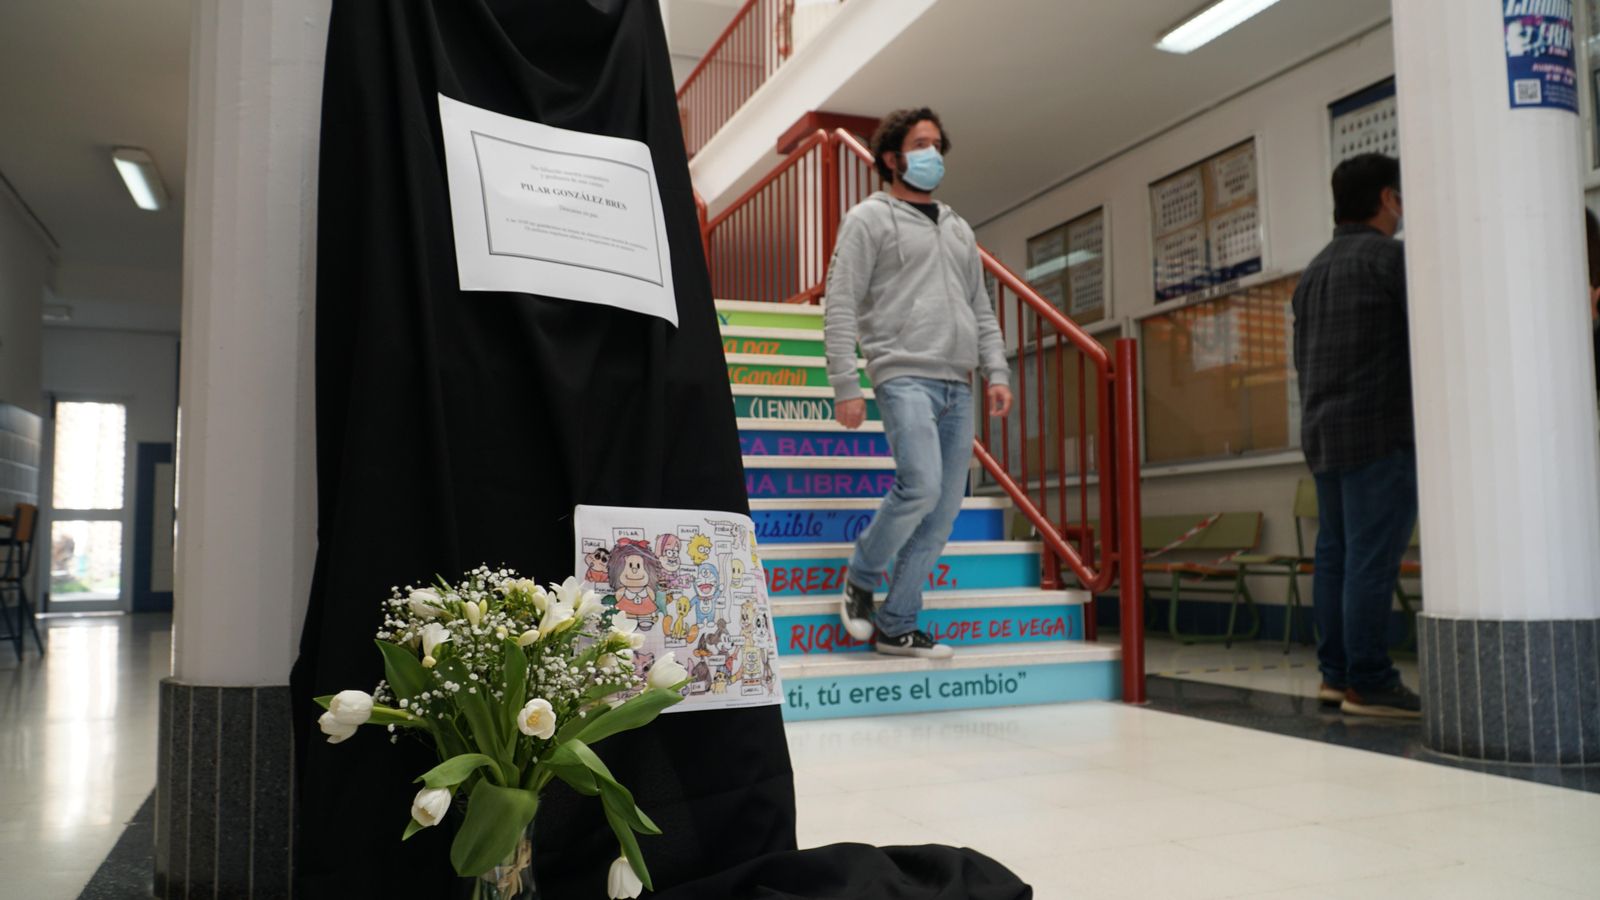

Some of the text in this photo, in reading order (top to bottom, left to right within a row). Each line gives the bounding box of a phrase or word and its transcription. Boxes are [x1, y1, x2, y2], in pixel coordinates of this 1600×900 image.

[520, 182, 551, 195] PILAR
[750, 397, 833, 420] (LENNON)
[778, 437, 894, 457] BATALL
[928, 620, 983, 640] (LOPE
[989, 619, 1012, 638] DE
[1018, 614, 1073, 638] VEGA)
[788, 671, 1027, 711] ti, tú eres el cambio”
